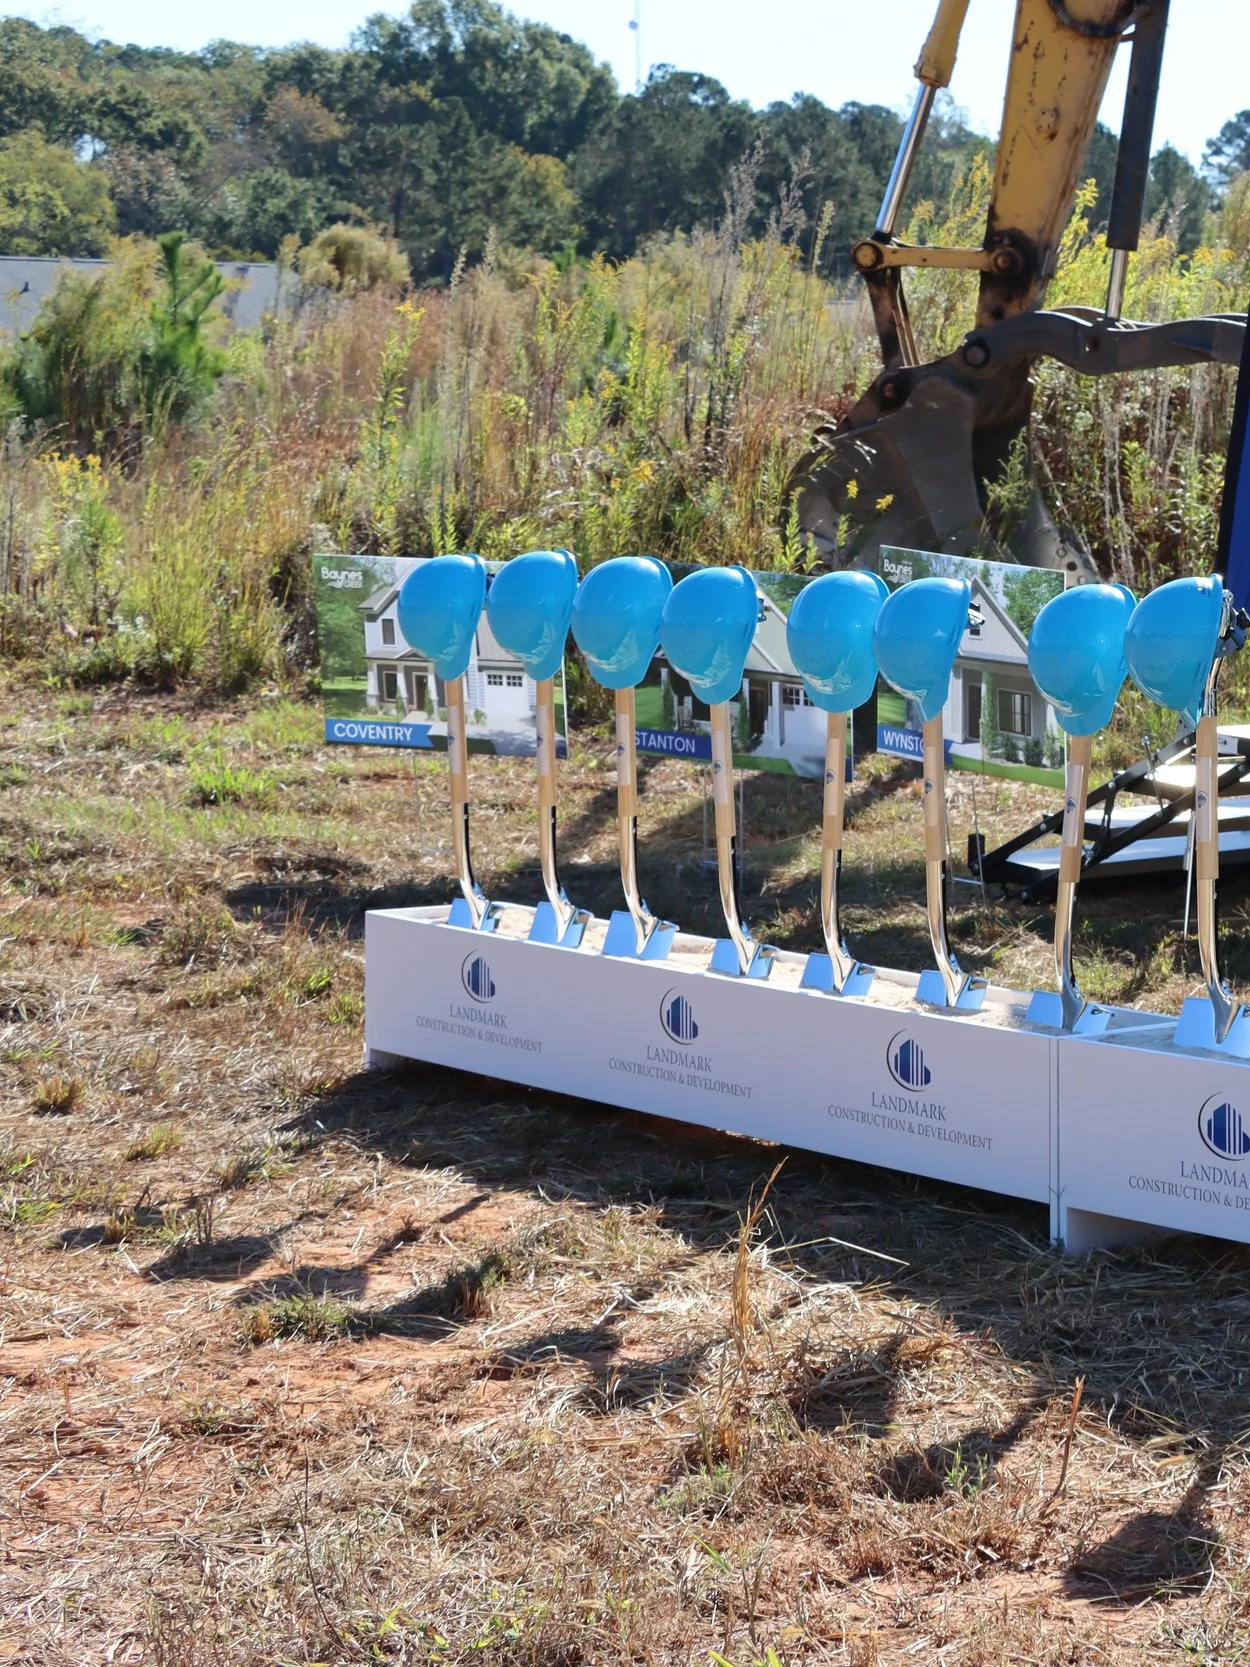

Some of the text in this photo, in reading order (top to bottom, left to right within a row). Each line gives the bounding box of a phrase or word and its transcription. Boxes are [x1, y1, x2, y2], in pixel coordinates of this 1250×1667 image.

[321, 567, 363, 587] Baynes
[883, 558, 913, 577] Baynes
[334, 722, 413, 742] COVENTRY
[883, 730, 924, 752] WYNST
[450, 1003, 507, 1029] LANDMARK
[416, 1015, 543, 1053] CONSTRUCTION & DEVELOPMENT
[646, 1045, 712, 1072] LANDMARK
[608, 1057, 752, 1099] CONSTRUCTION & DEVELOPMENT
[871, 1092, 947, 1121] LANDMARK
[828, 1104, 993, 1150] CONSTRUCTION & DEVELOPMENT
[1128, 1175, 1221, 1207] CONSTRUCTION
[1223, 1194, 1232, 1207] &
